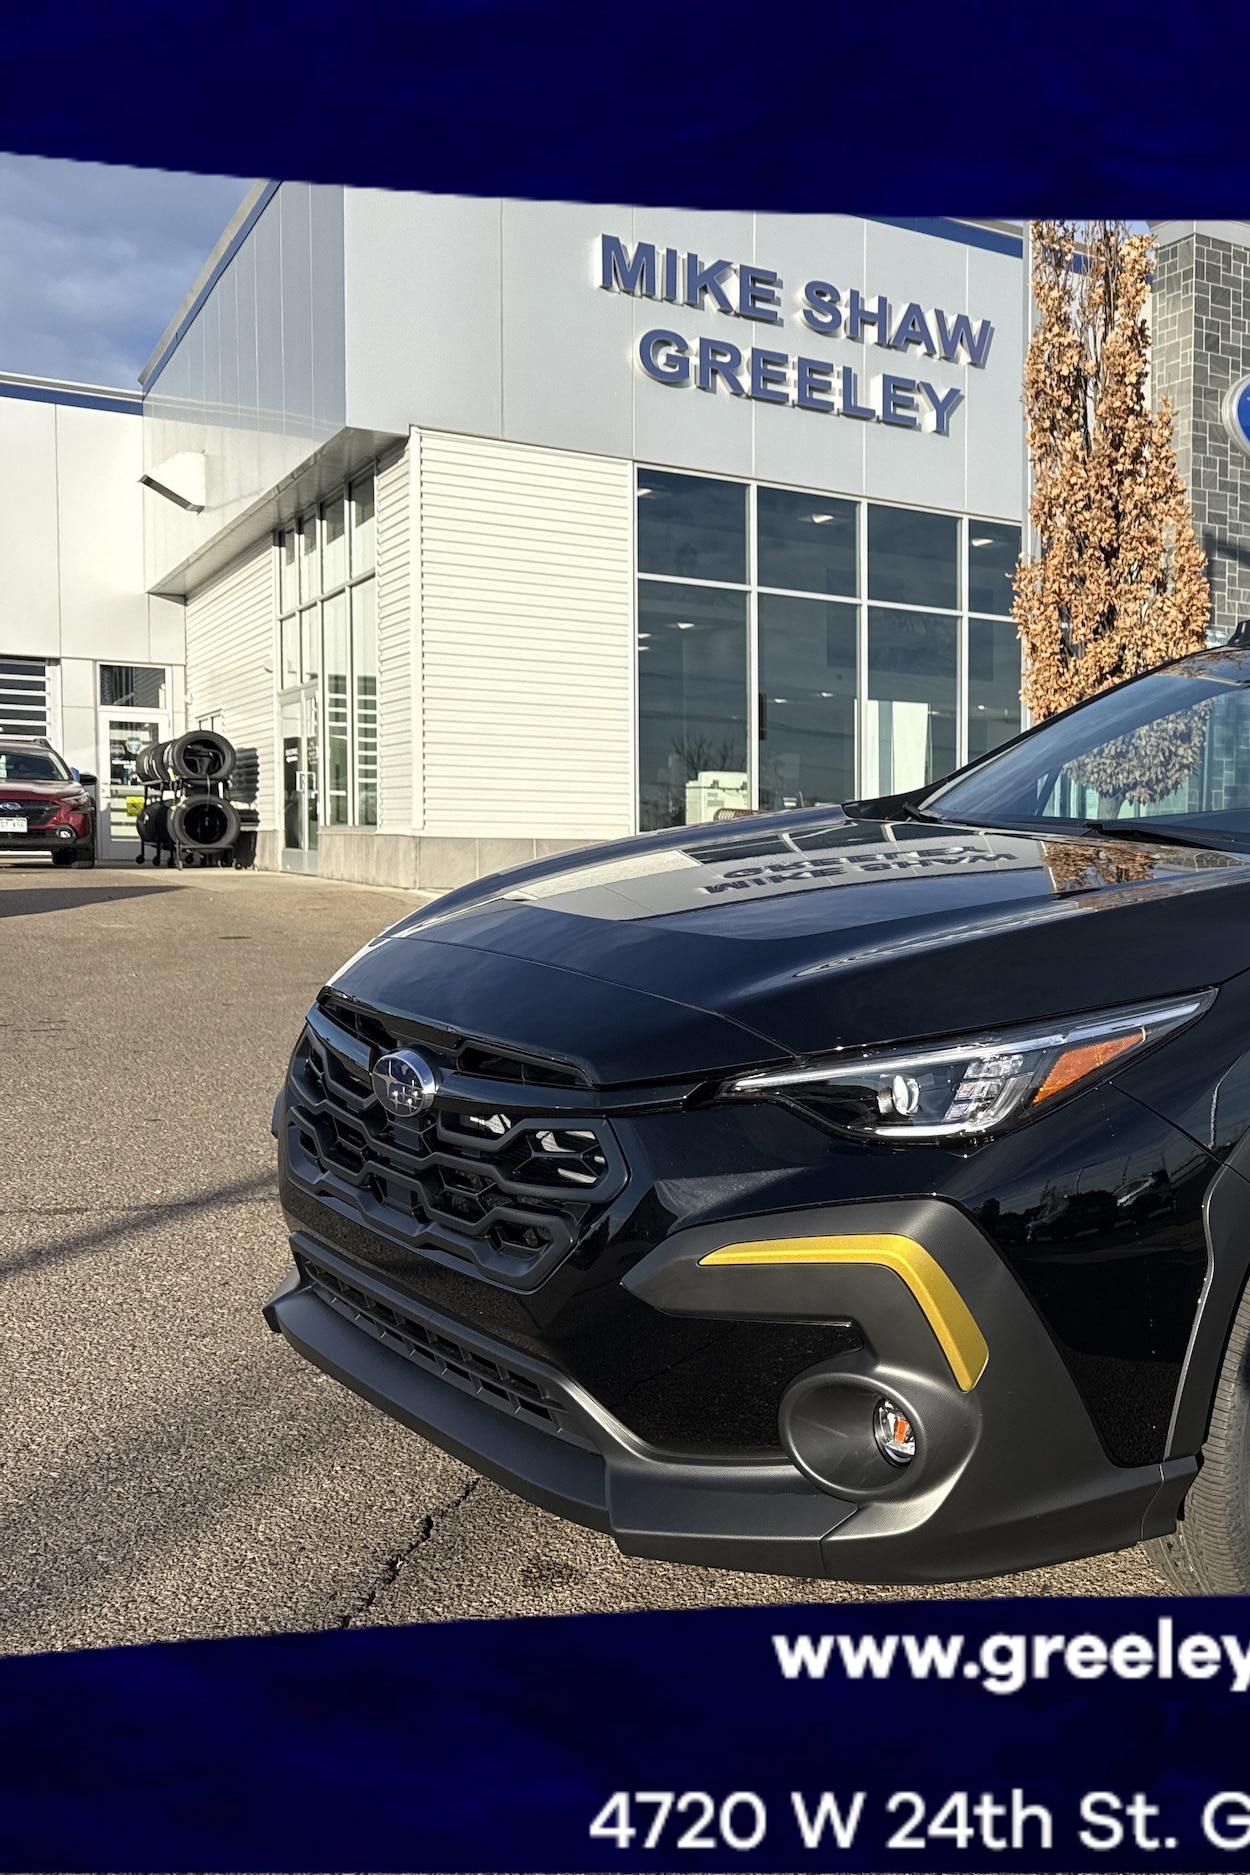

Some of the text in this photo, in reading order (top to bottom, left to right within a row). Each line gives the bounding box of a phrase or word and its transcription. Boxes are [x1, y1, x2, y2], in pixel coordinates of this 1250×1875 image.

[601, 234, 994, 366] MIKE SHAW
[638, 329, 962, 434] GREELEY
